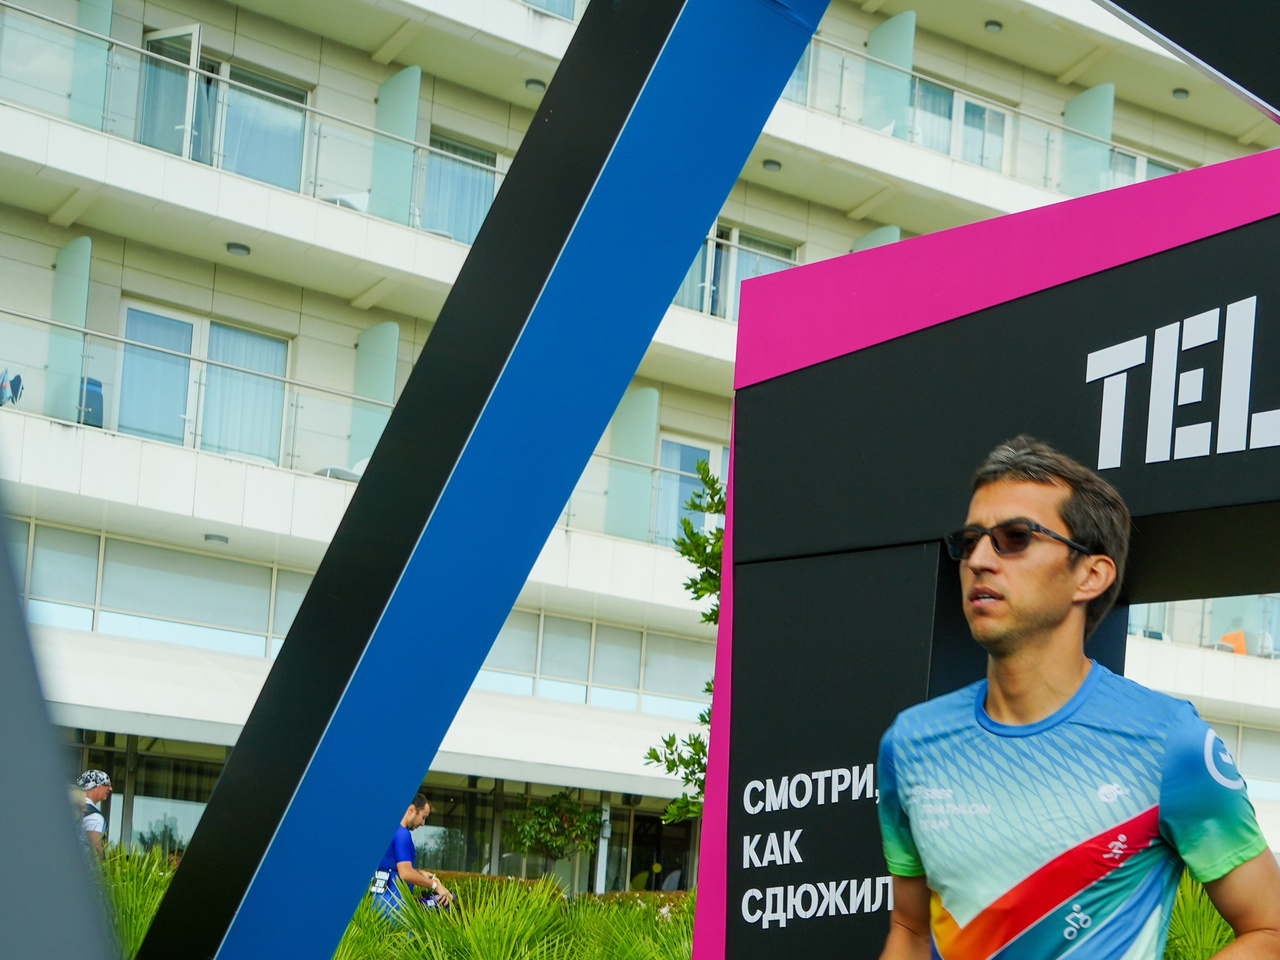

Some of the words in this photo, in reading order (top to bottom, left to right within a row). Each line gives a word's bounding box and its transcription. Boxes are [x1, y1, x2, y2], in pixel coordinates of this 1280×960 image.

[743, 763, 880, 815] СМОТРИ,
[743, 829, 803, 869] КАК
[741, 876, 894, 930] СДЮЖИЛ
